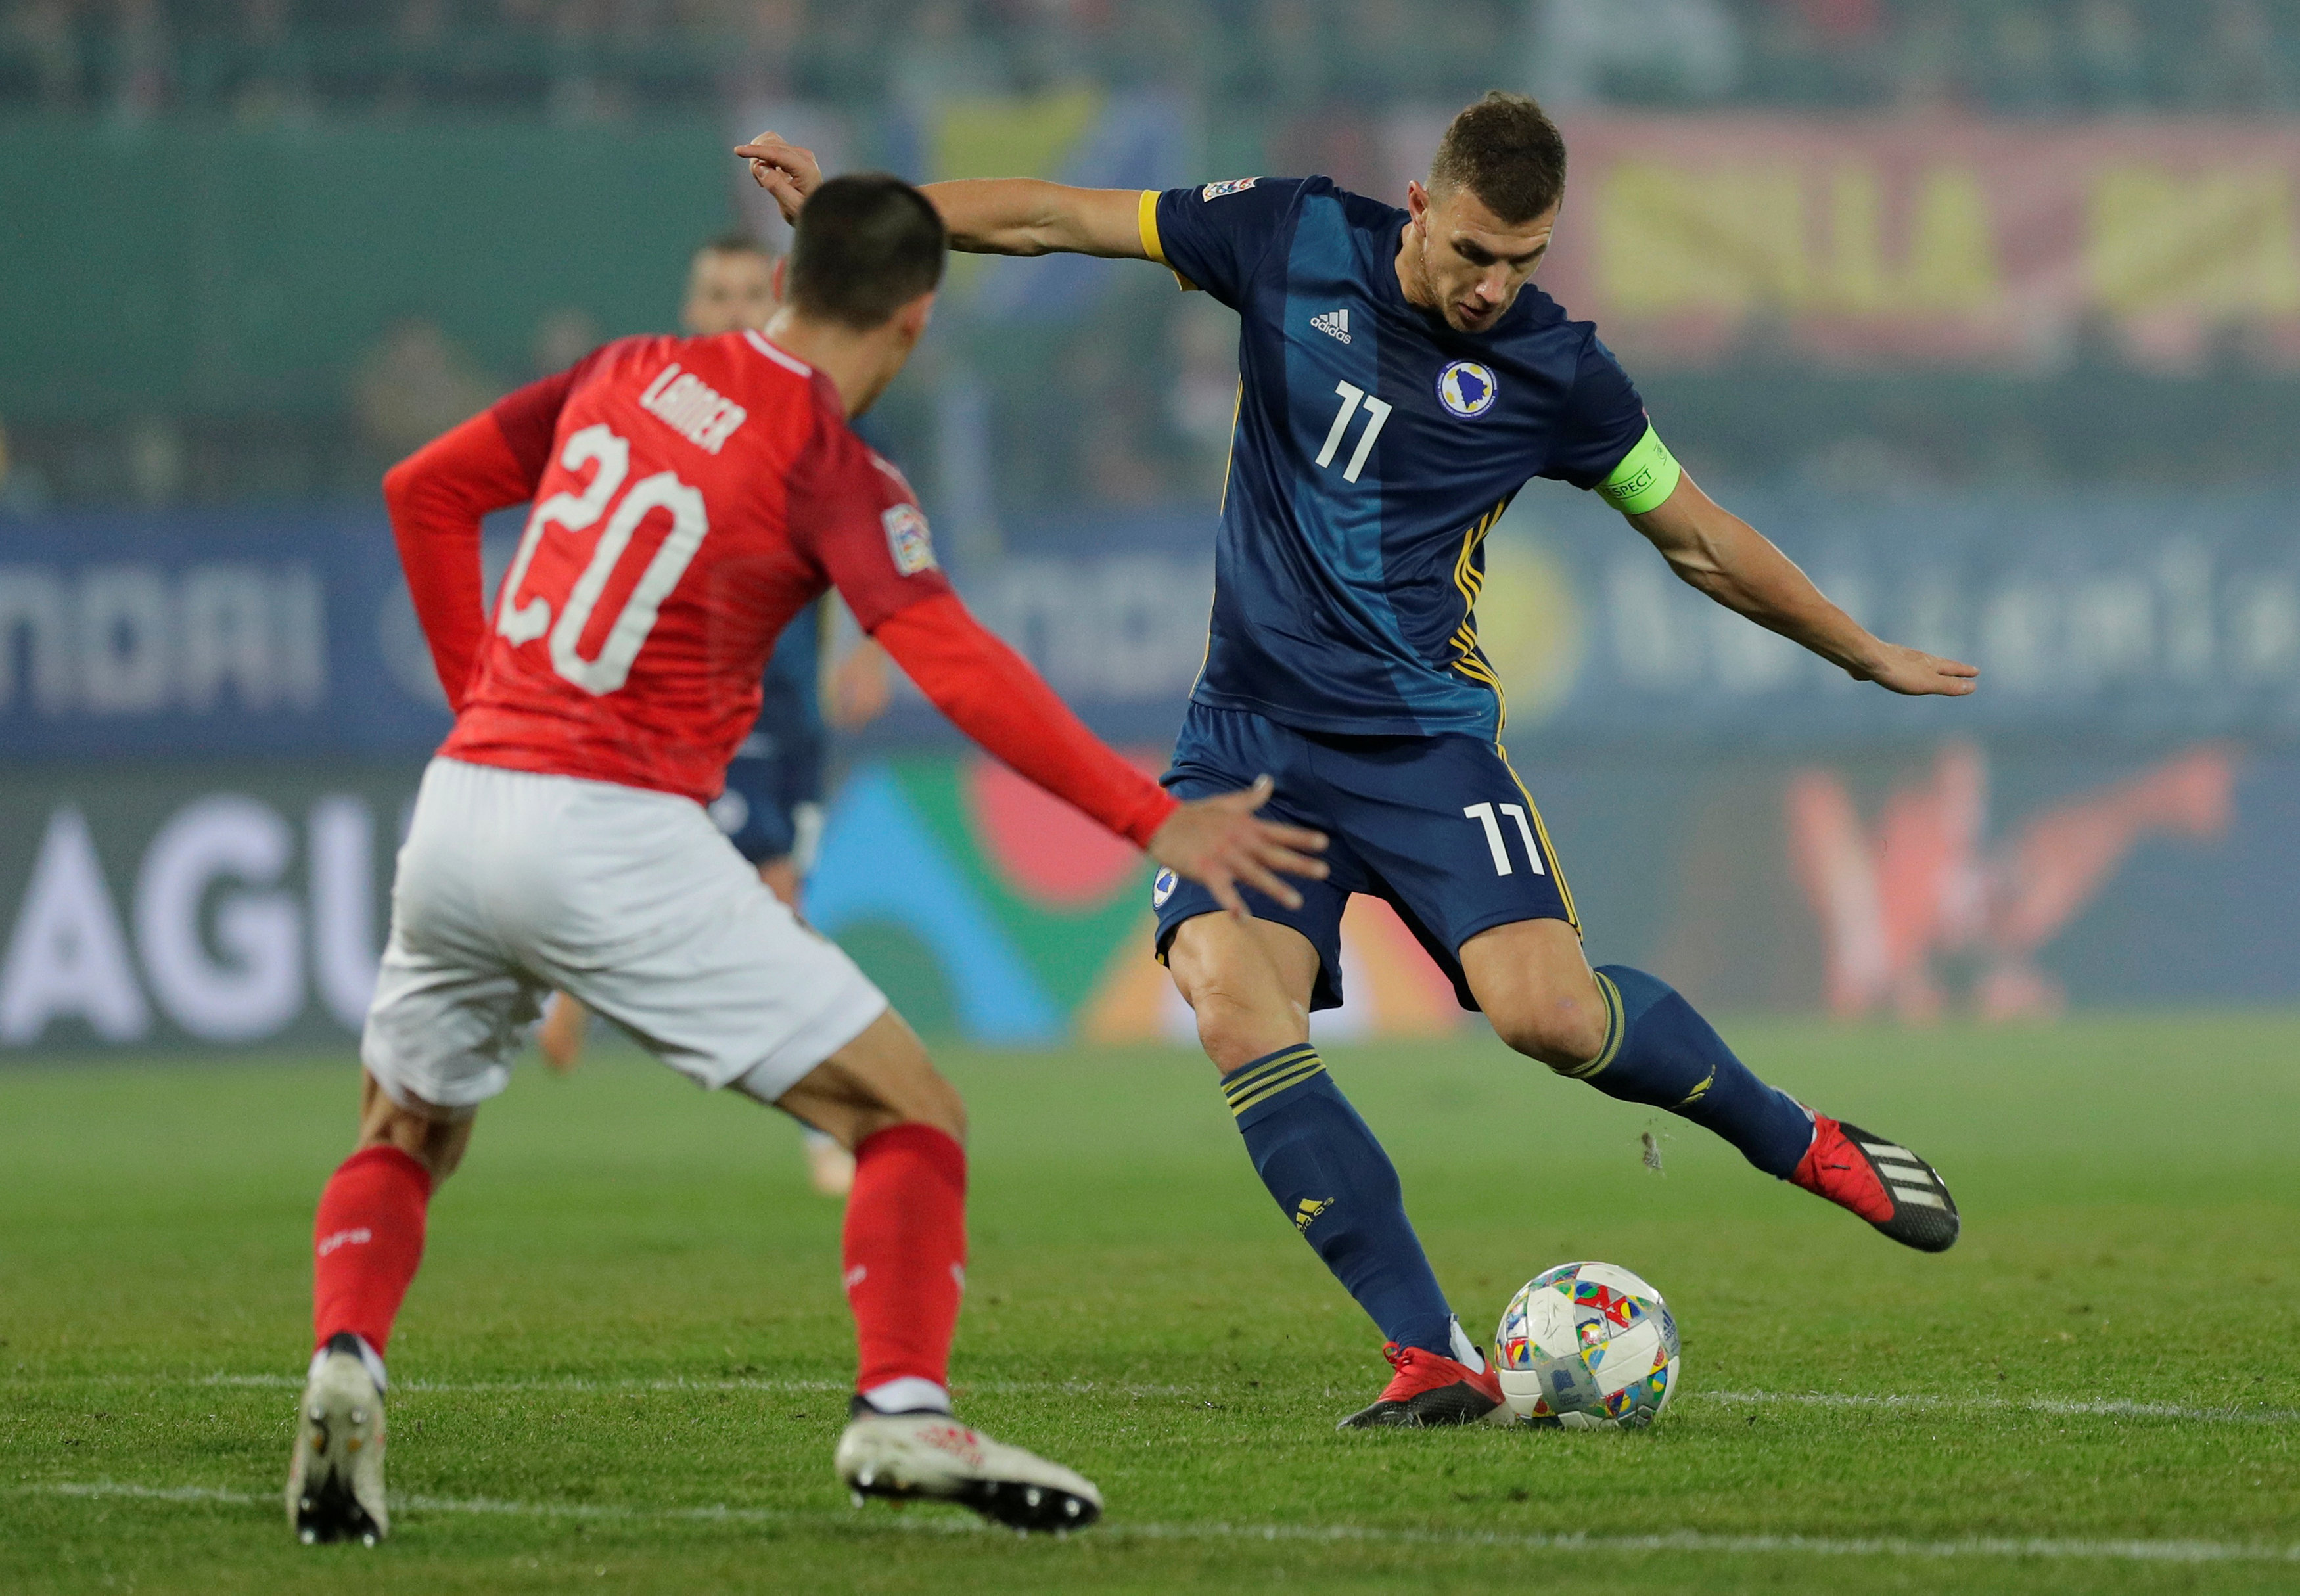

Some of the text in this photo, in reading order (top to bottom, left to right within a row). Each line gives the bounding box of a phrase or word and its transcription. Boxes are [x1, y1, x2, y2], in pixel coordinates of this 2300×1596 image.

[1310, 317, 1352, 345] adidas
[1314, 379, 1393, 484] 11
[496, 423, 709, 697] 20
[1463, 802, 1545, 877] 11
